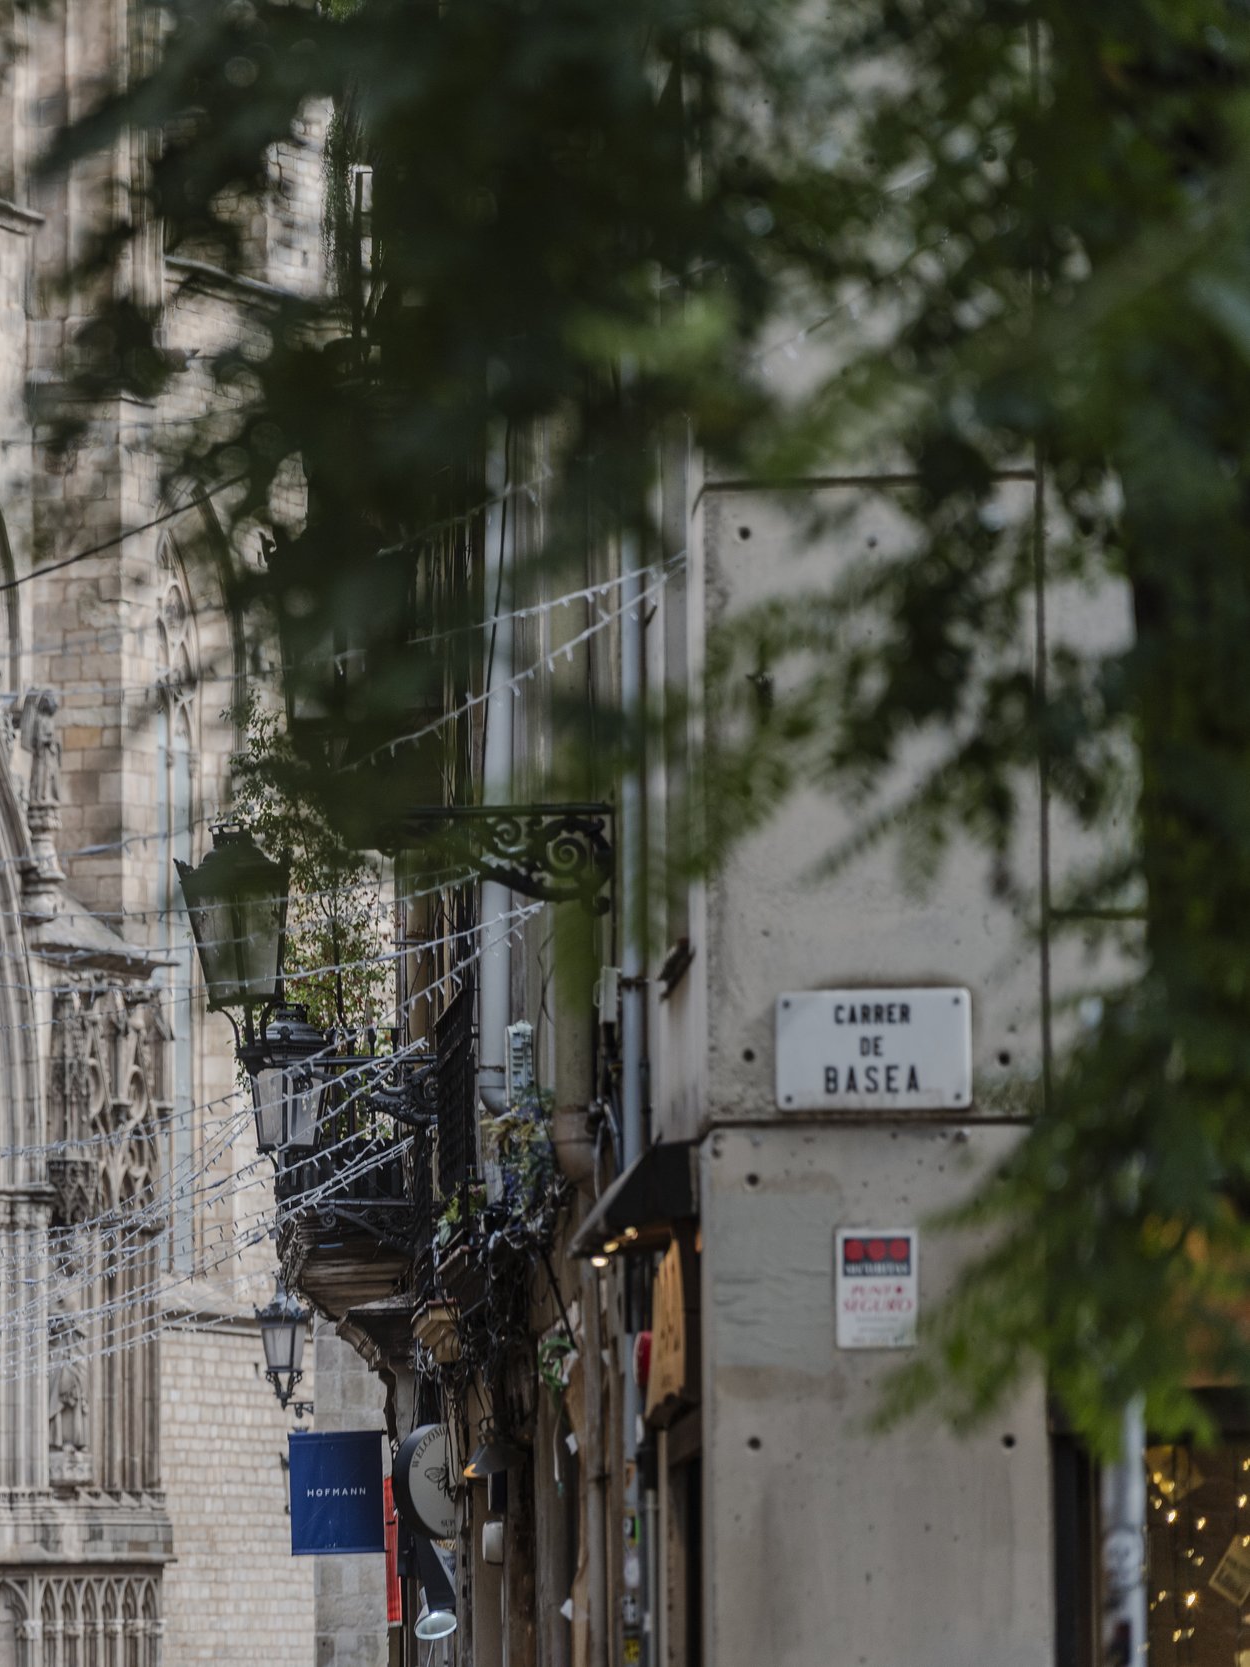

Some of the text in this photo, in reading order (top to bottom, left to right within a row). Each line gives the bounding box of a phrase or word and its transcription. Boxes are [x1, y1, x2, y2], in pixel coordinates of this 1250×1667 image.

[834, 1003, 910, 1025] CARRER
[859, 1036, 884, 1057] DE
[824, 1064, 920, 1094] BASEA
[306, 1487, 367, 1498] HOFMANN
